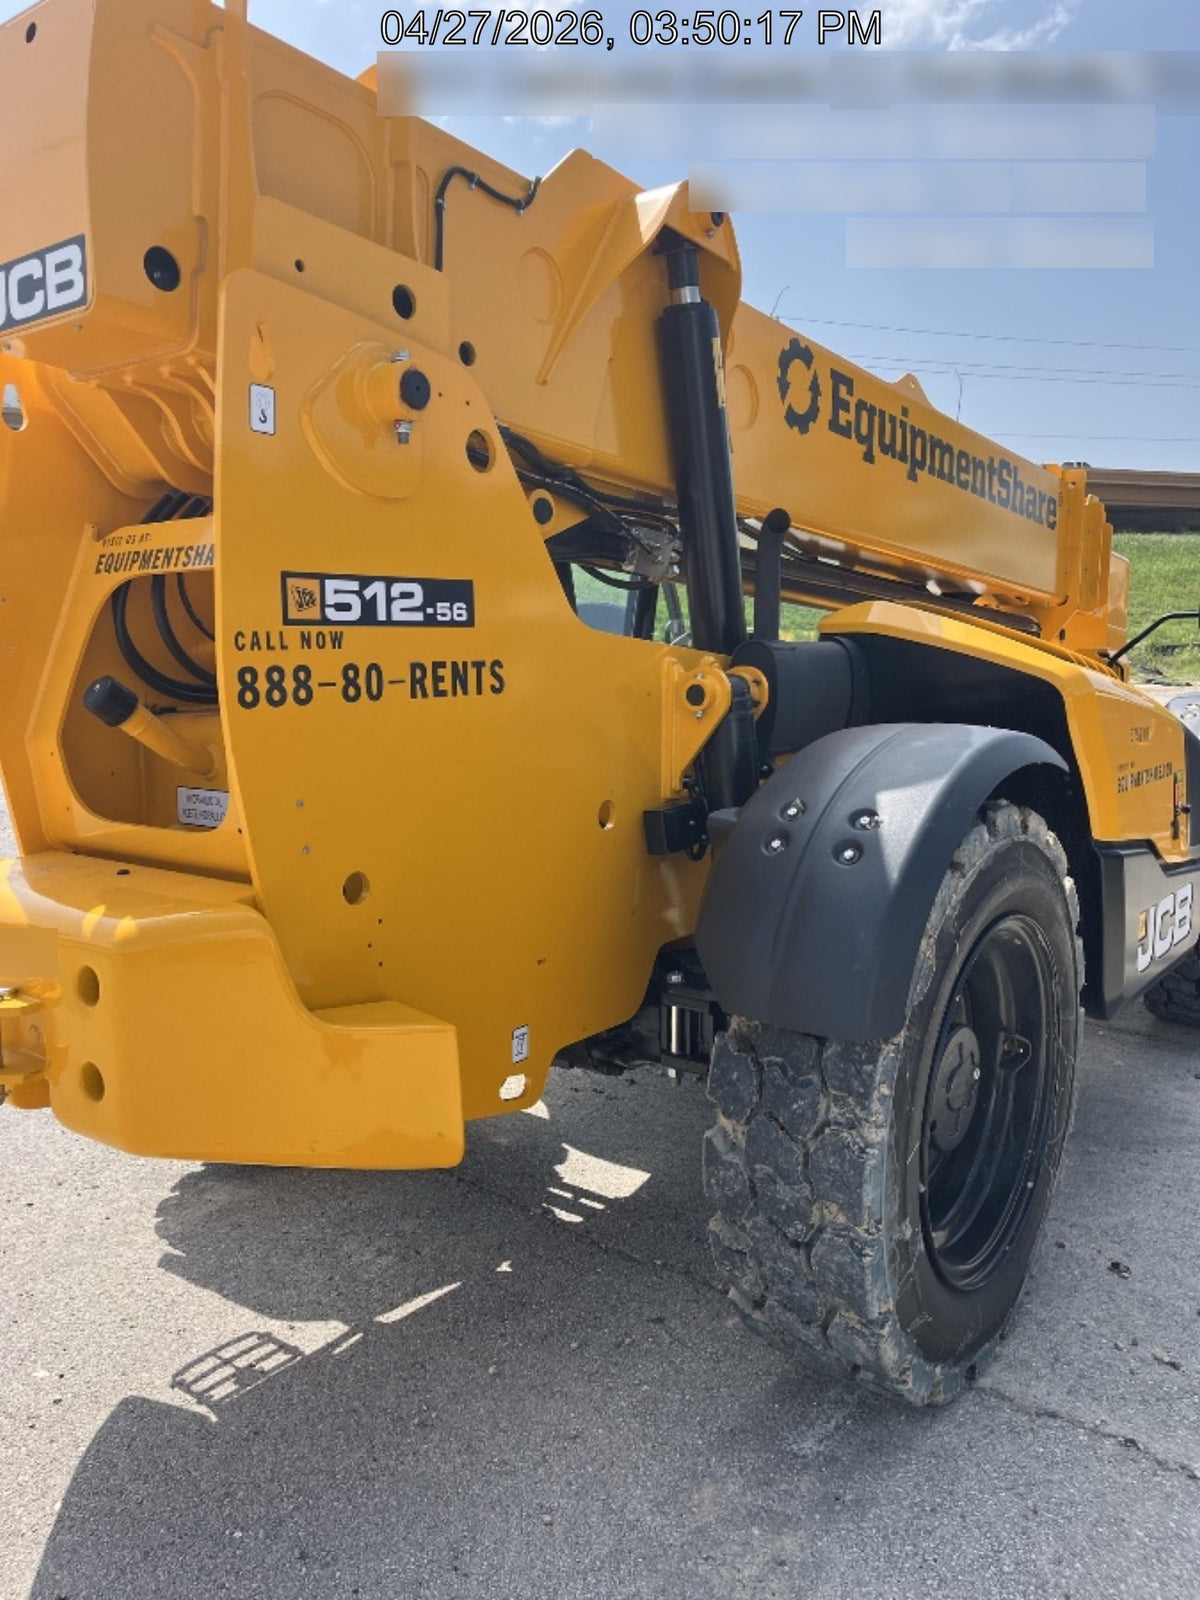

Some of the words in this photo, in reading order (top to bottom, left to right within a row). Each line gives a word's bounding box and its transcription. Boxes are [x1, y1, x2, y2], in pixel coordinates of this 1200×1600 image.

[828, 367, 1057, 530] EquipmentShare
[234, 631, 289, 651] CALL
[301, 630, 344, 650] NOW
[237, 659, 505, 710] 888-80-RENTS
[1136, 881, 1194, 974] JCB
